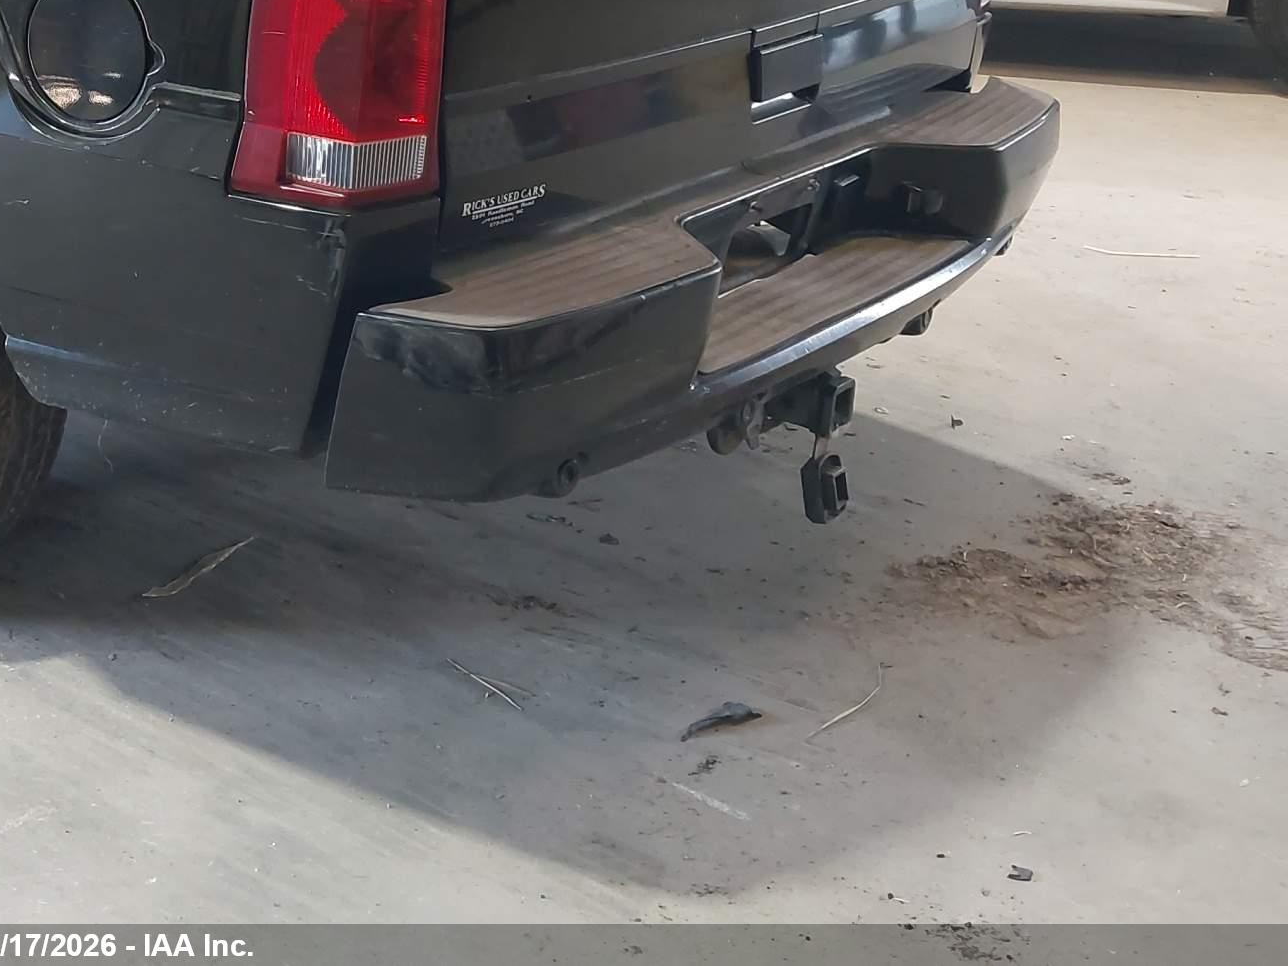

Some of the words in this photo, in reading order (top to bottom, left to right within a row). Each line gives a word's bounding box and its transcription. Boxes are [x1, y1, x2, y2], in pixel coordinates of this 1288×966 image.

[462, 196, 495, 216] RICK'S
[497, 190, 520, 205] USED
[520, 184, 546, 199] CARS
